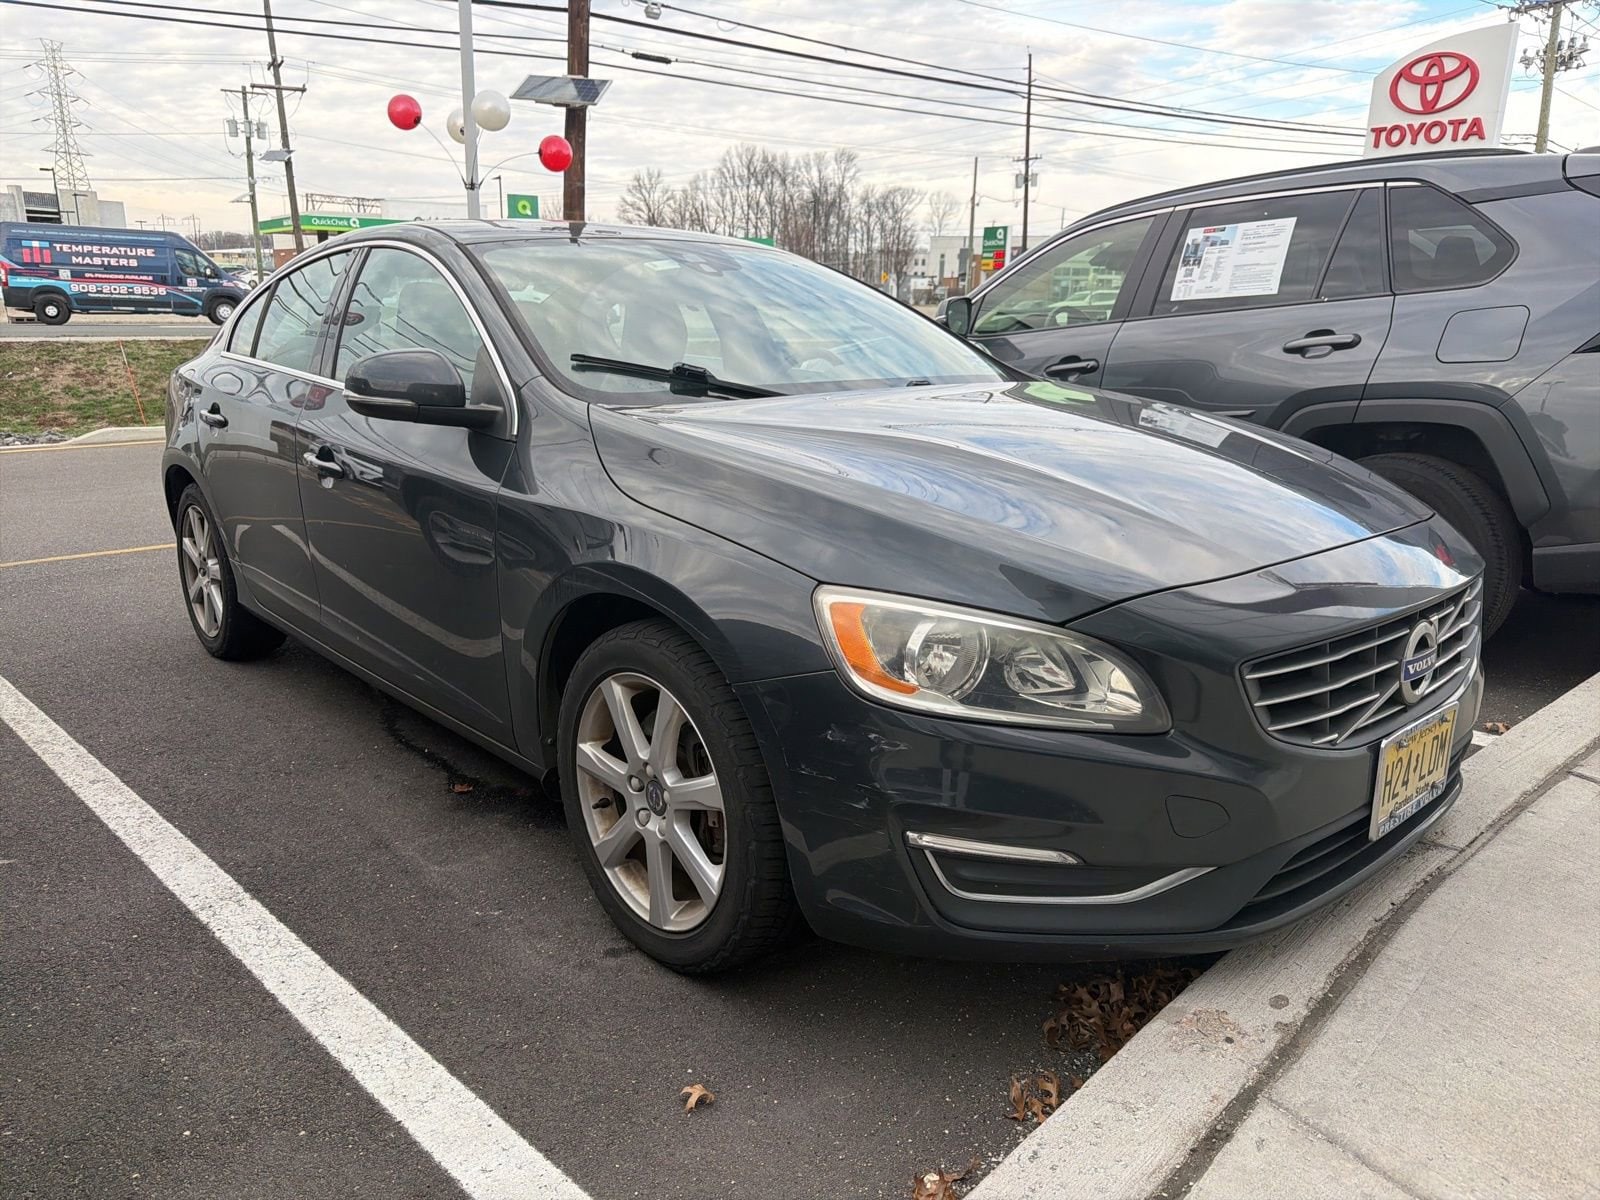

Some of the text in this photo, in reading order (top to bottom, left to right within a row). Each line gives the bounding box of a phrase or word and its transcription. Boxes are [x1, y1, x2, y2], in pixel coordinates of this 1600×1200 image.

[1371, 117, 1485, 149] TOYOTA
[312, 217, 349, 226] QuickChek
[53, 243, 156, 257] TEMPERATURE
[71, 256, 138, 267] MASTERS
[1418, 722, 1438, 744] Jersey
[1382, 729, 1449, 807] H24 LDM
[1393, 780, 1430, 813] Garden State
